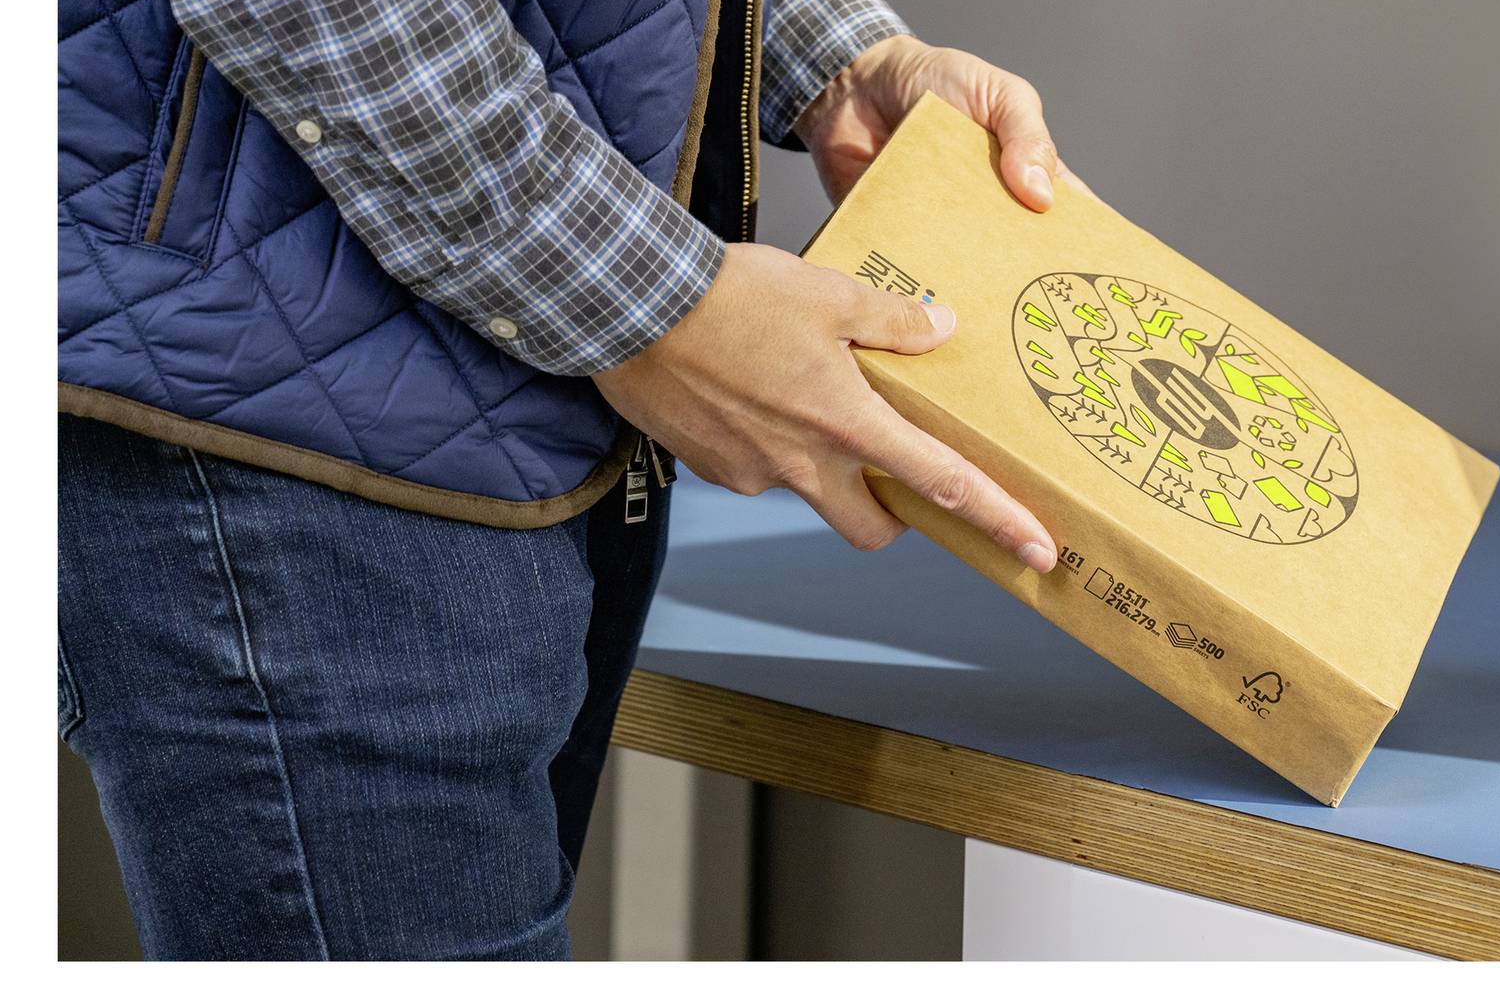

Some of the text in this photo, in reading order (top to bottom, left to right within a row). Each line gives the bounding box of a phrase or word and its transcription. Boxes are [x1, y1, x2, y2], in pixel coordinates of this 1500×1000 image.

[1060, 546, 1085, 569] 161
[1198, 637, 1224, 660] 500
[1235, 691, 1270, 720] FSC
